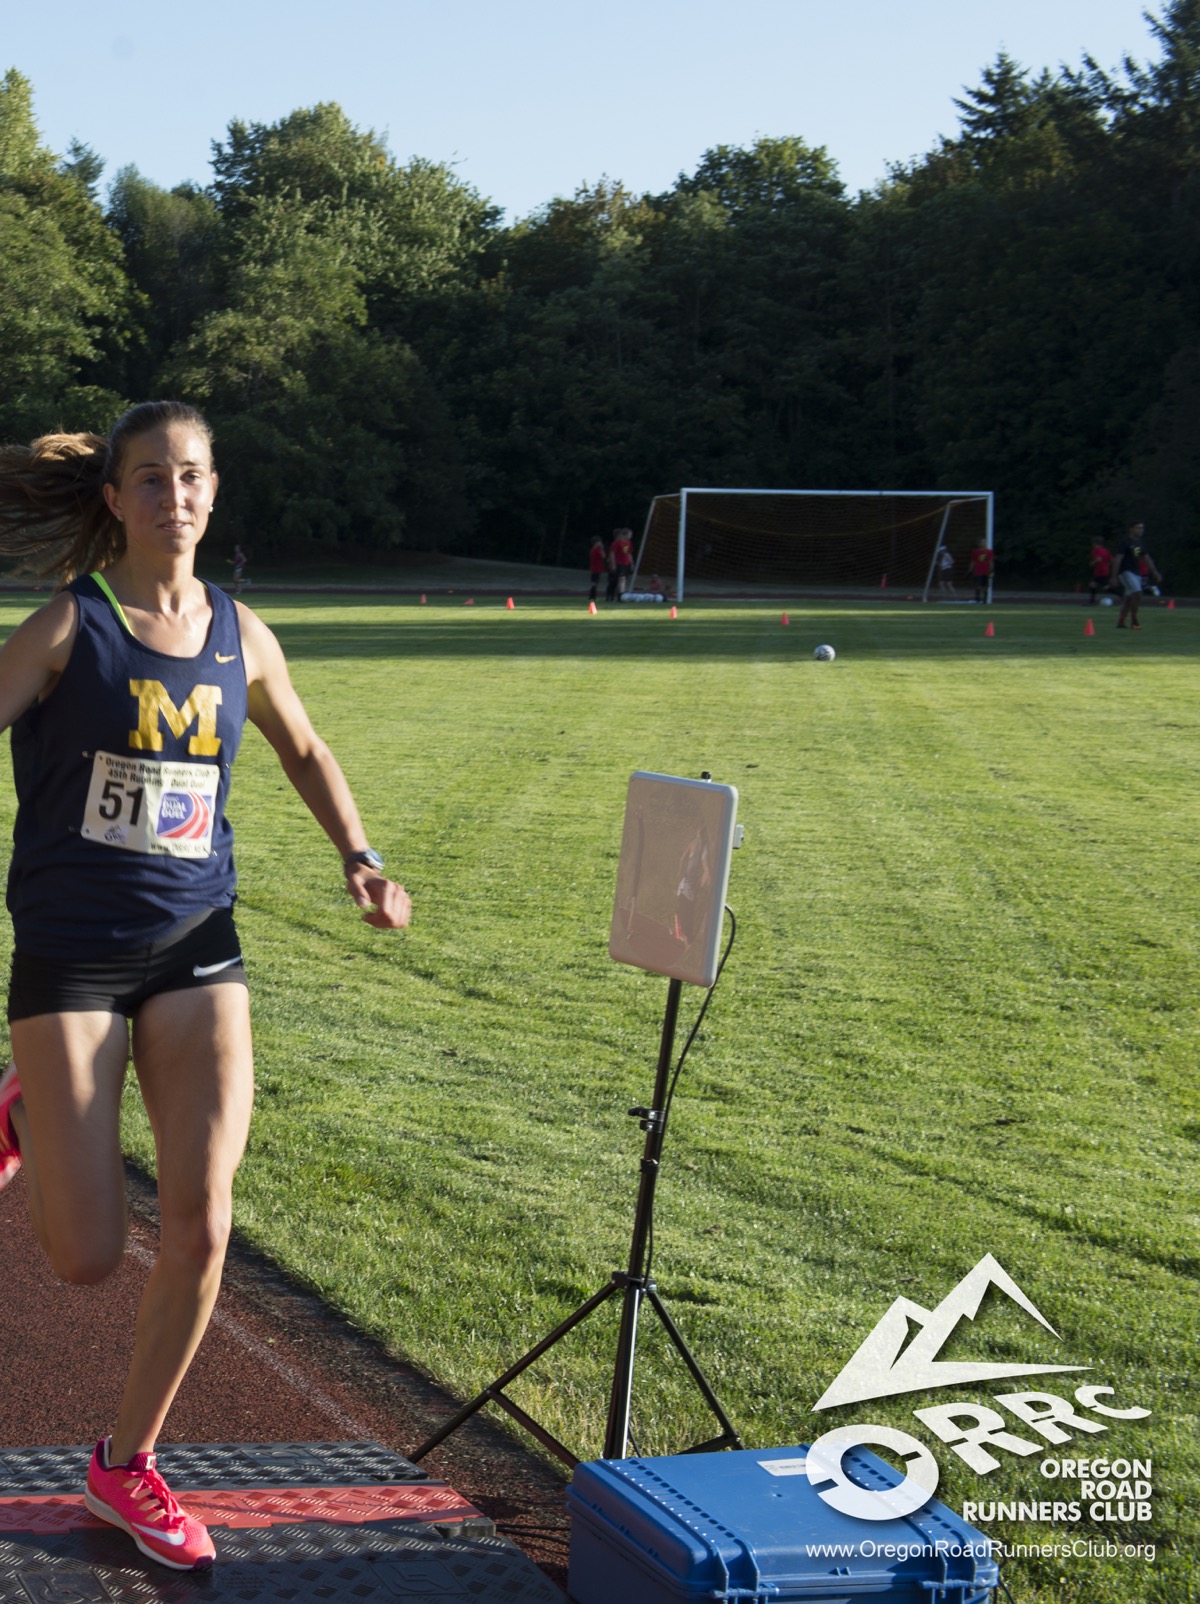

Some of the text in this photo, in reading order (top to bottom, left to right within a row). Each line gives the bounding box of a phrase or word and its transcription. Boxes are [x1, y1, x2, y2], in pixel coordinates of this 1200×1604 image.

[128, 678, 223, 756] M
[105, 757, 137, 772] Oregon
[139, 763, 160, 775] Road
[108, 767, 128, 780] 45th
[99, 780, 144, 826] 51
